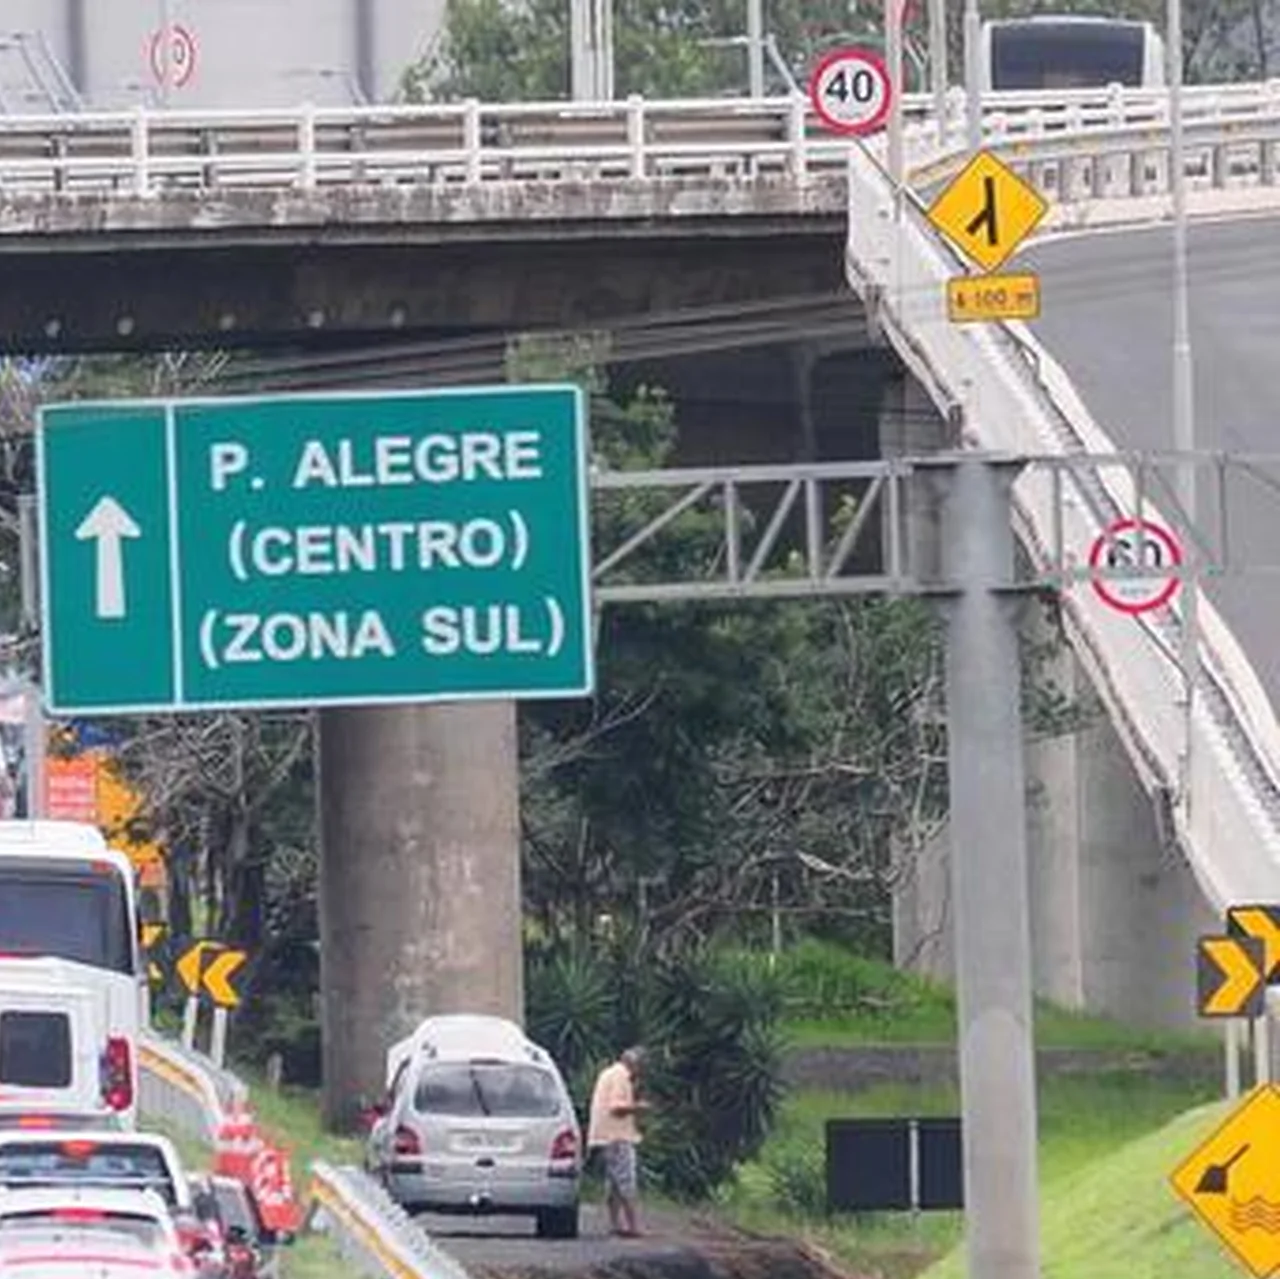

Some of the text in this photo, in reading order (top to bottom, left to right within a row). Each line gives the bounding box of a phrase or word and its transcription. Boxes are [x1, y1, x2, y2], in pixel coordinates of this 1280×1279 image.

[825, 69, 873, 102] 40
[210, 431, 543, 491] P. ALEGRE
[229, 510, 529, 580] (CENTRO)
[199, 598, 565, 669] (ZONA SUL)
